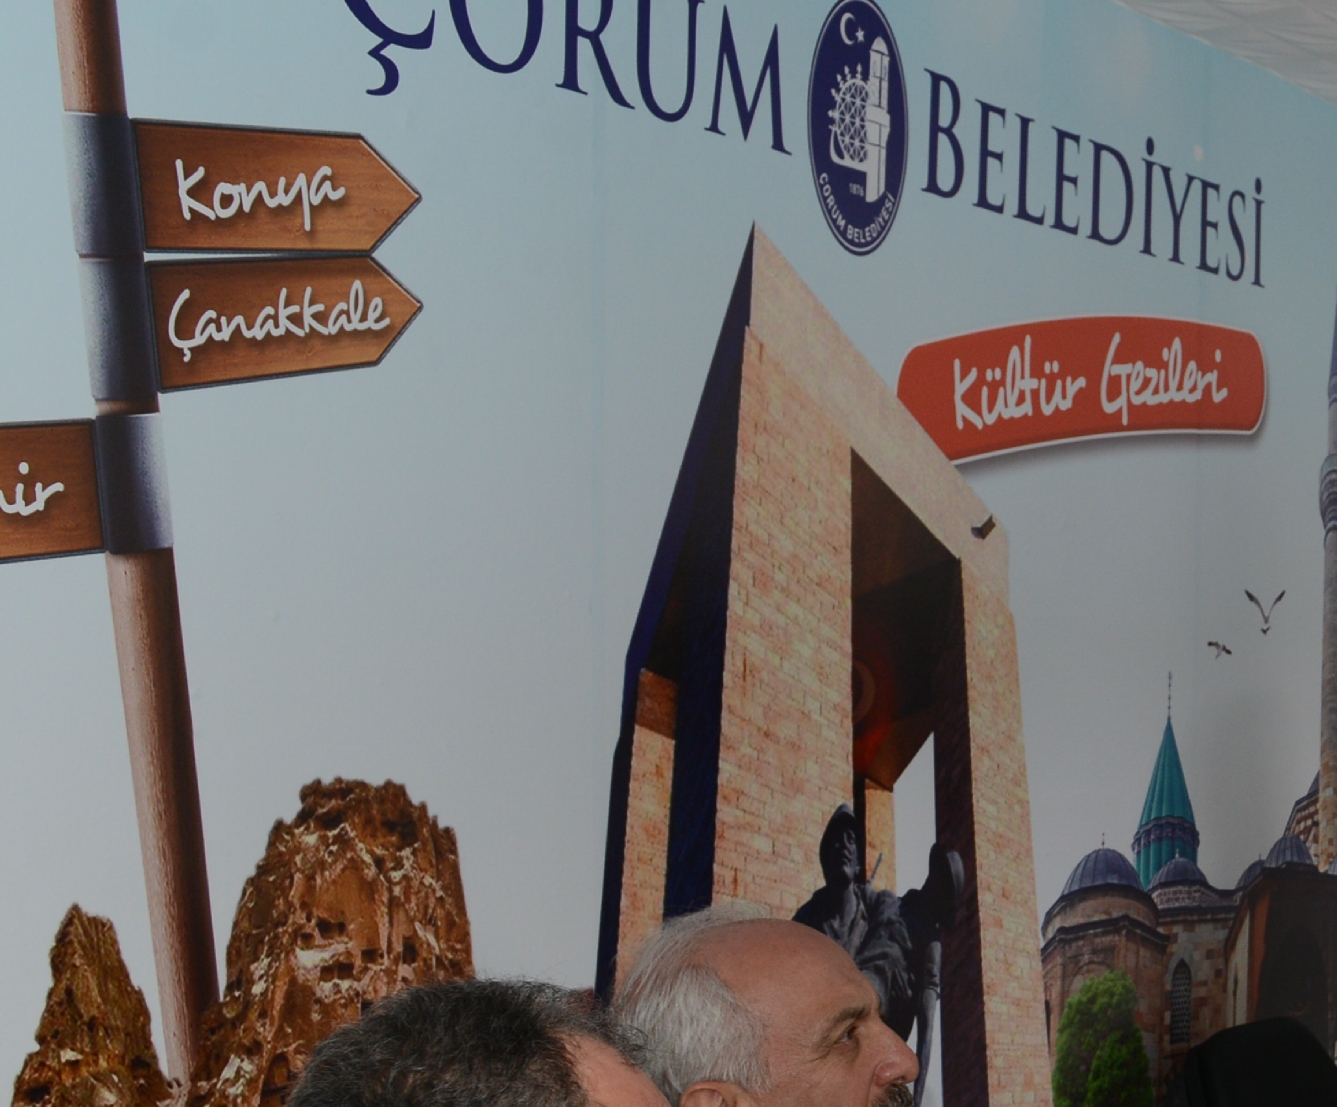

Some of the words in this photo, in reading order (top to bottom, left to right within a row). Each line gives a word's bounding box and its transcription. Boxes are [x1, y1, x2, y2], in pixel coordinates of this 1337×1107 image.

[175, 158, 345, 232] Konya
[921, 67, 1265, 288] BELEDİYESİ
[168, 279, 391, 363] Çanakkale
[953, 334, 1087, 431] Kültür
[1101, 331, 1229, 426] Gezileri
[0, 461, 65, 516] ir
